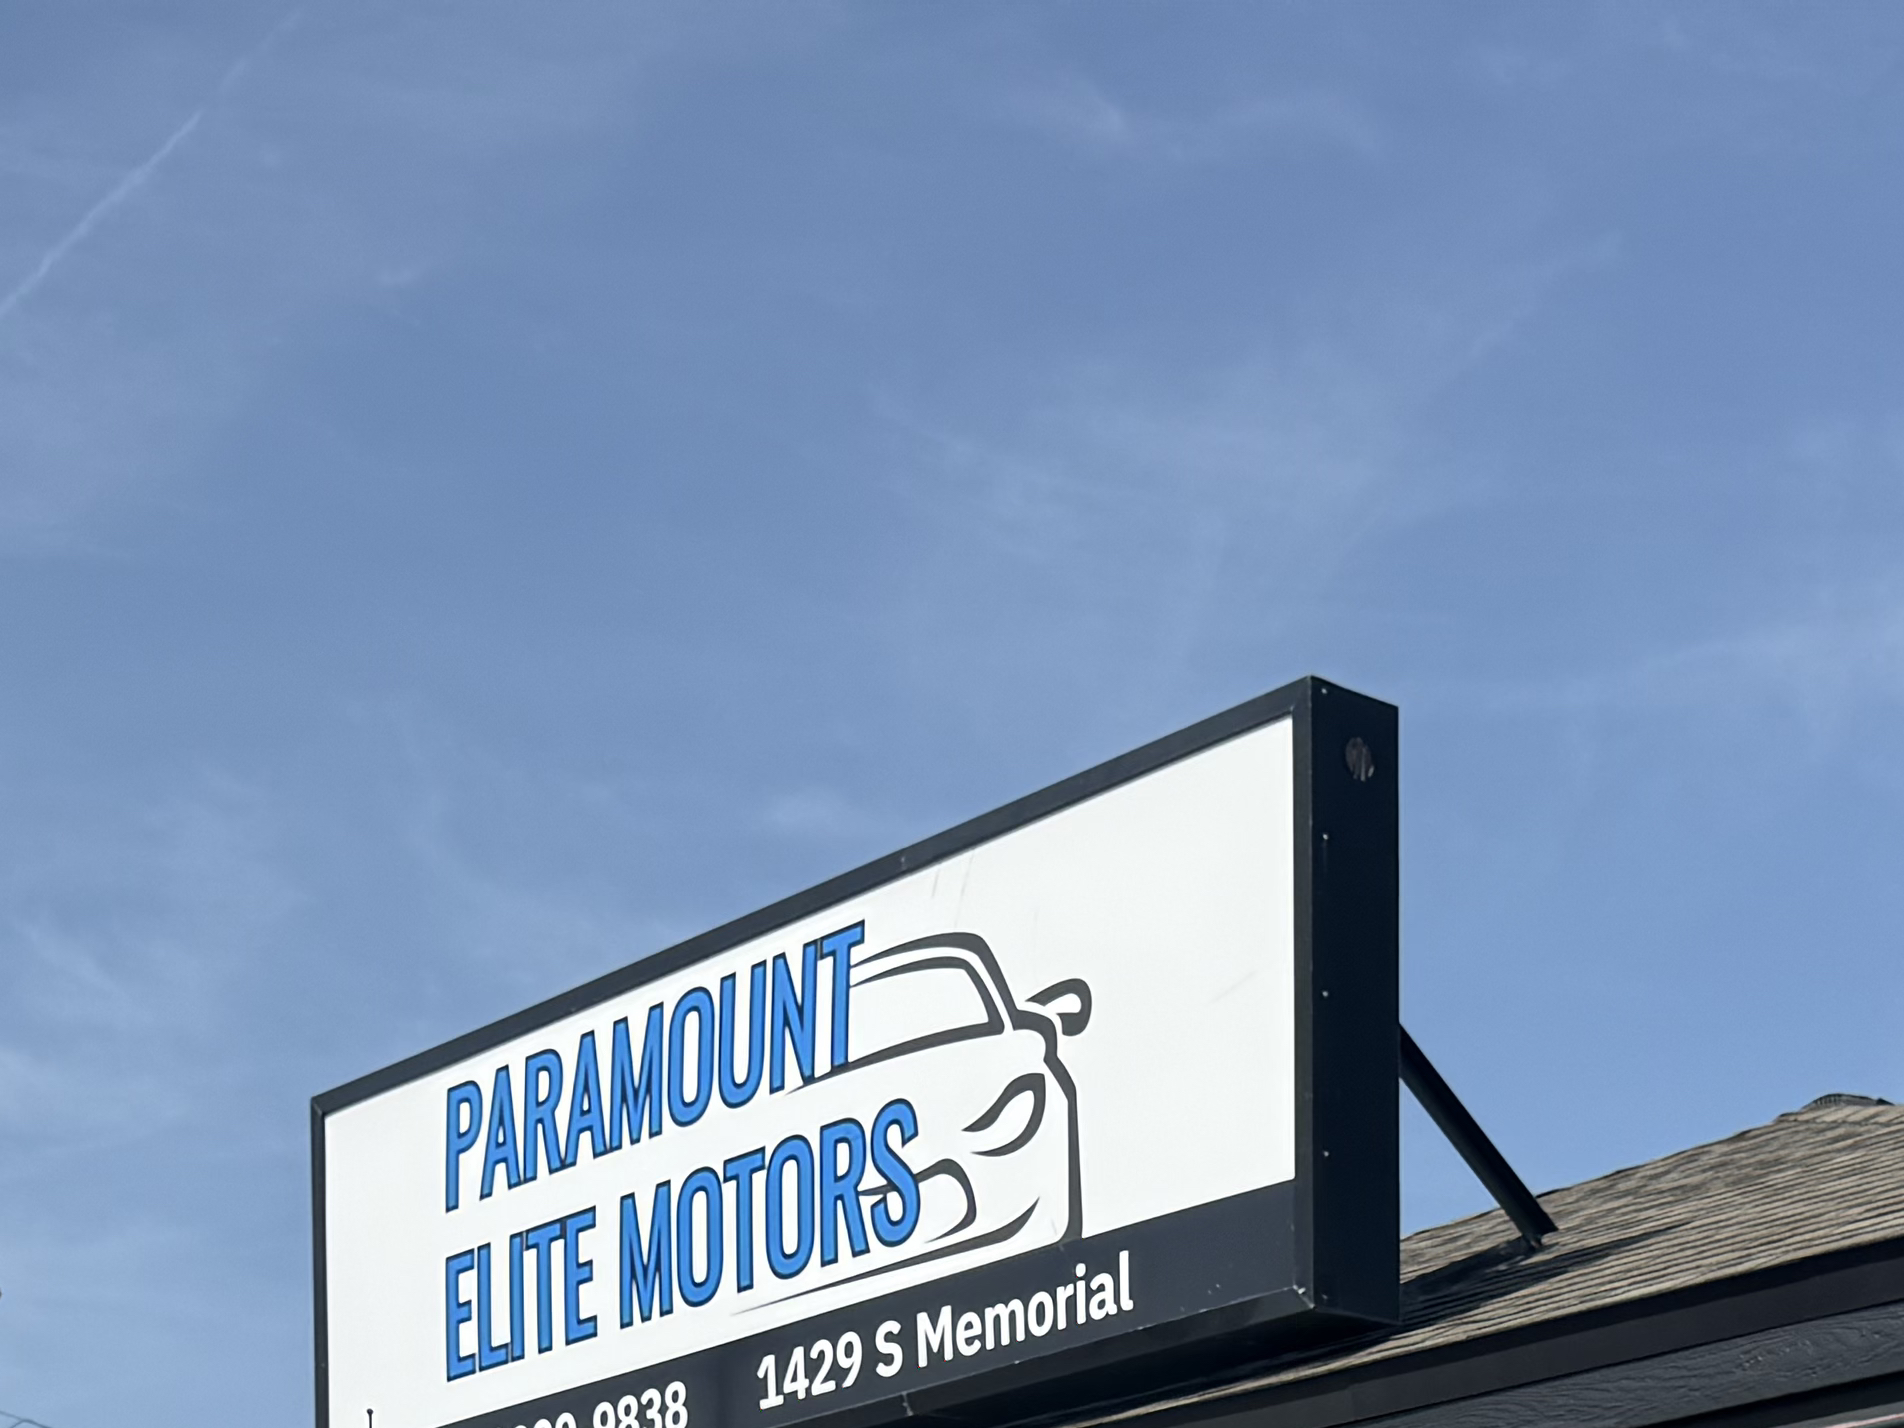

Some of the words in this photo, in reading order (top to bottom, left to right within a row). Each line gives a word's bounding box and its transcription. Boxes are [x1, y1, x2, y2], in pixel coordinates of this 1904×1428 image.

[446, 919, 865, 1213] PARAMOUNT
[446, 1205, 598, 1382] ELITE
[619, 1098, 921, 1329] MOTORS
[757, 1331, 863, 1410] 1429
[875, 1320, 903, 1377] S
[916, 1250, 1134, 1368] Memorial
